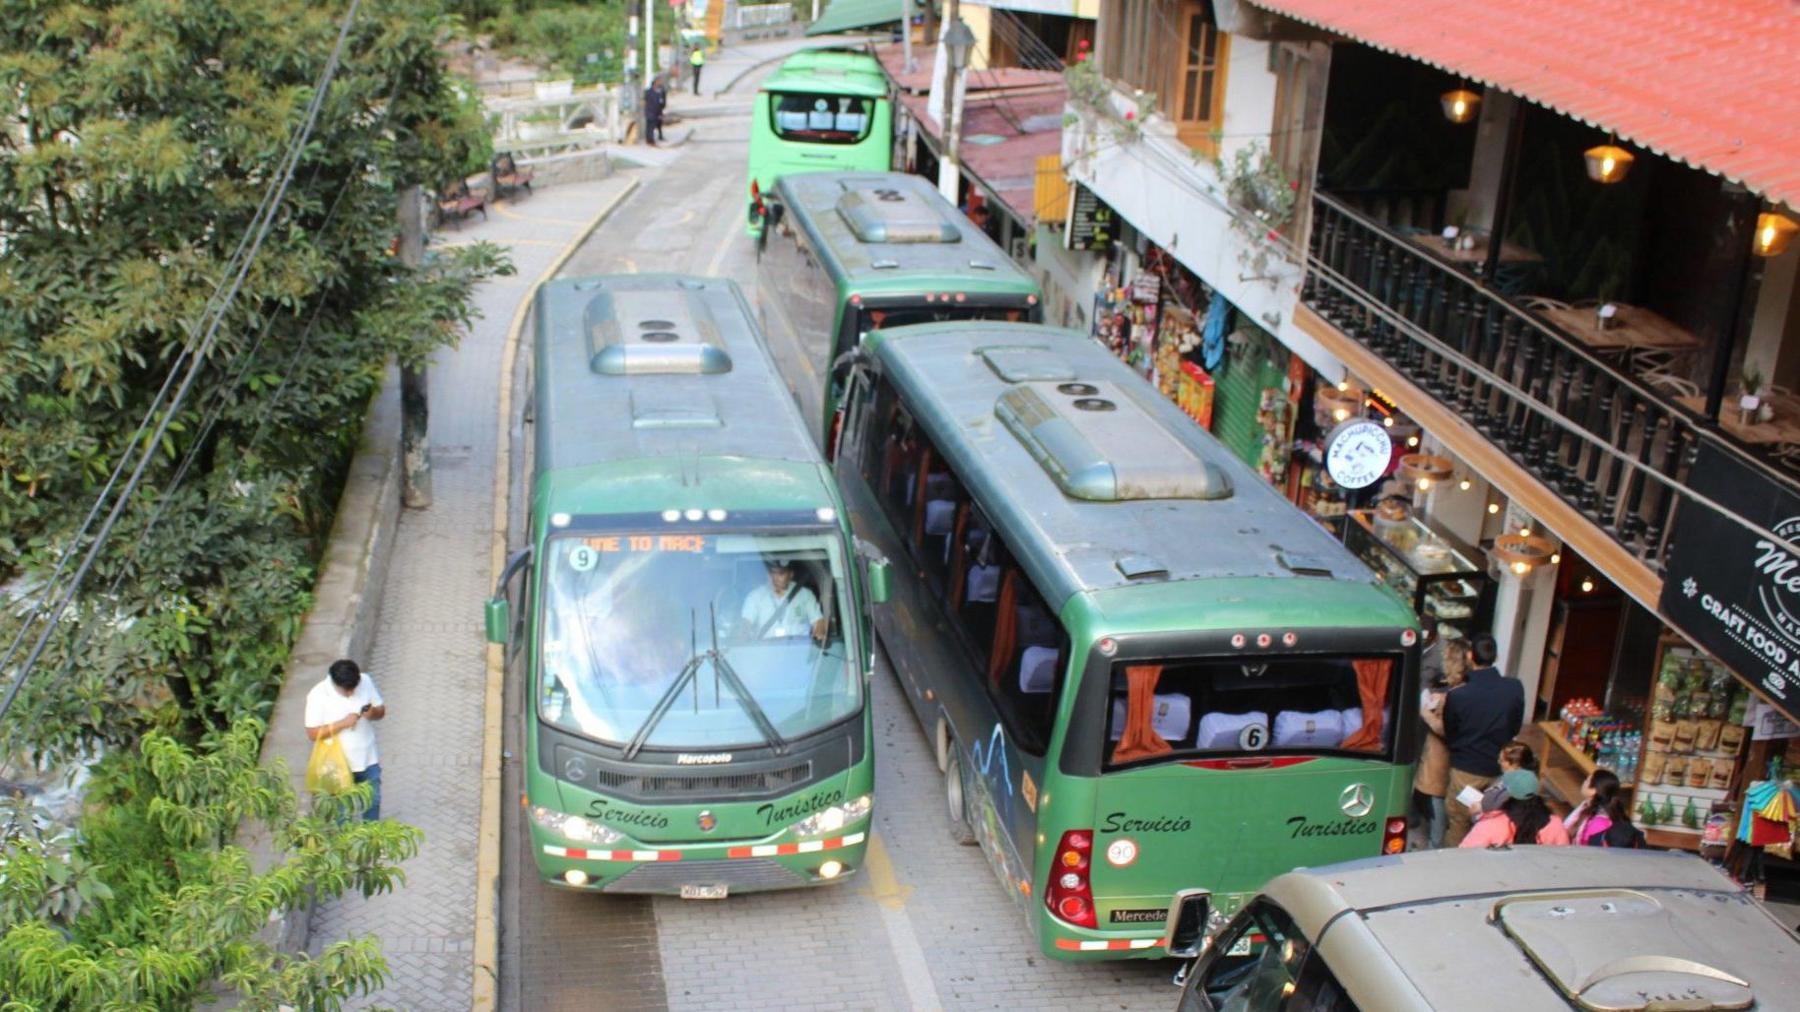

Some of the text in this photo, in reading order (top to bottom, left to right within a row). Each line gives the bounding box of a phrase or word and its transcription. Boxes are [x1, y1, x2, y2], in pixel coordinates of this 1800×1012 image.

[1336, 470, 1376, 484] COFFEE
[628, 534, 653, 552] TO
[578, 549, 589, 568] 9
[1701, 593, 1800, 679] CRAFT FOOD A
[1248, 728, 1261, 748] 6
[677, 753, 732, 765] Marcopolo
[584, 799, 669, 829] Servicio
[1100, 811, 1192, 834] Servicio
[1110, 845, 1133, 860] 90
